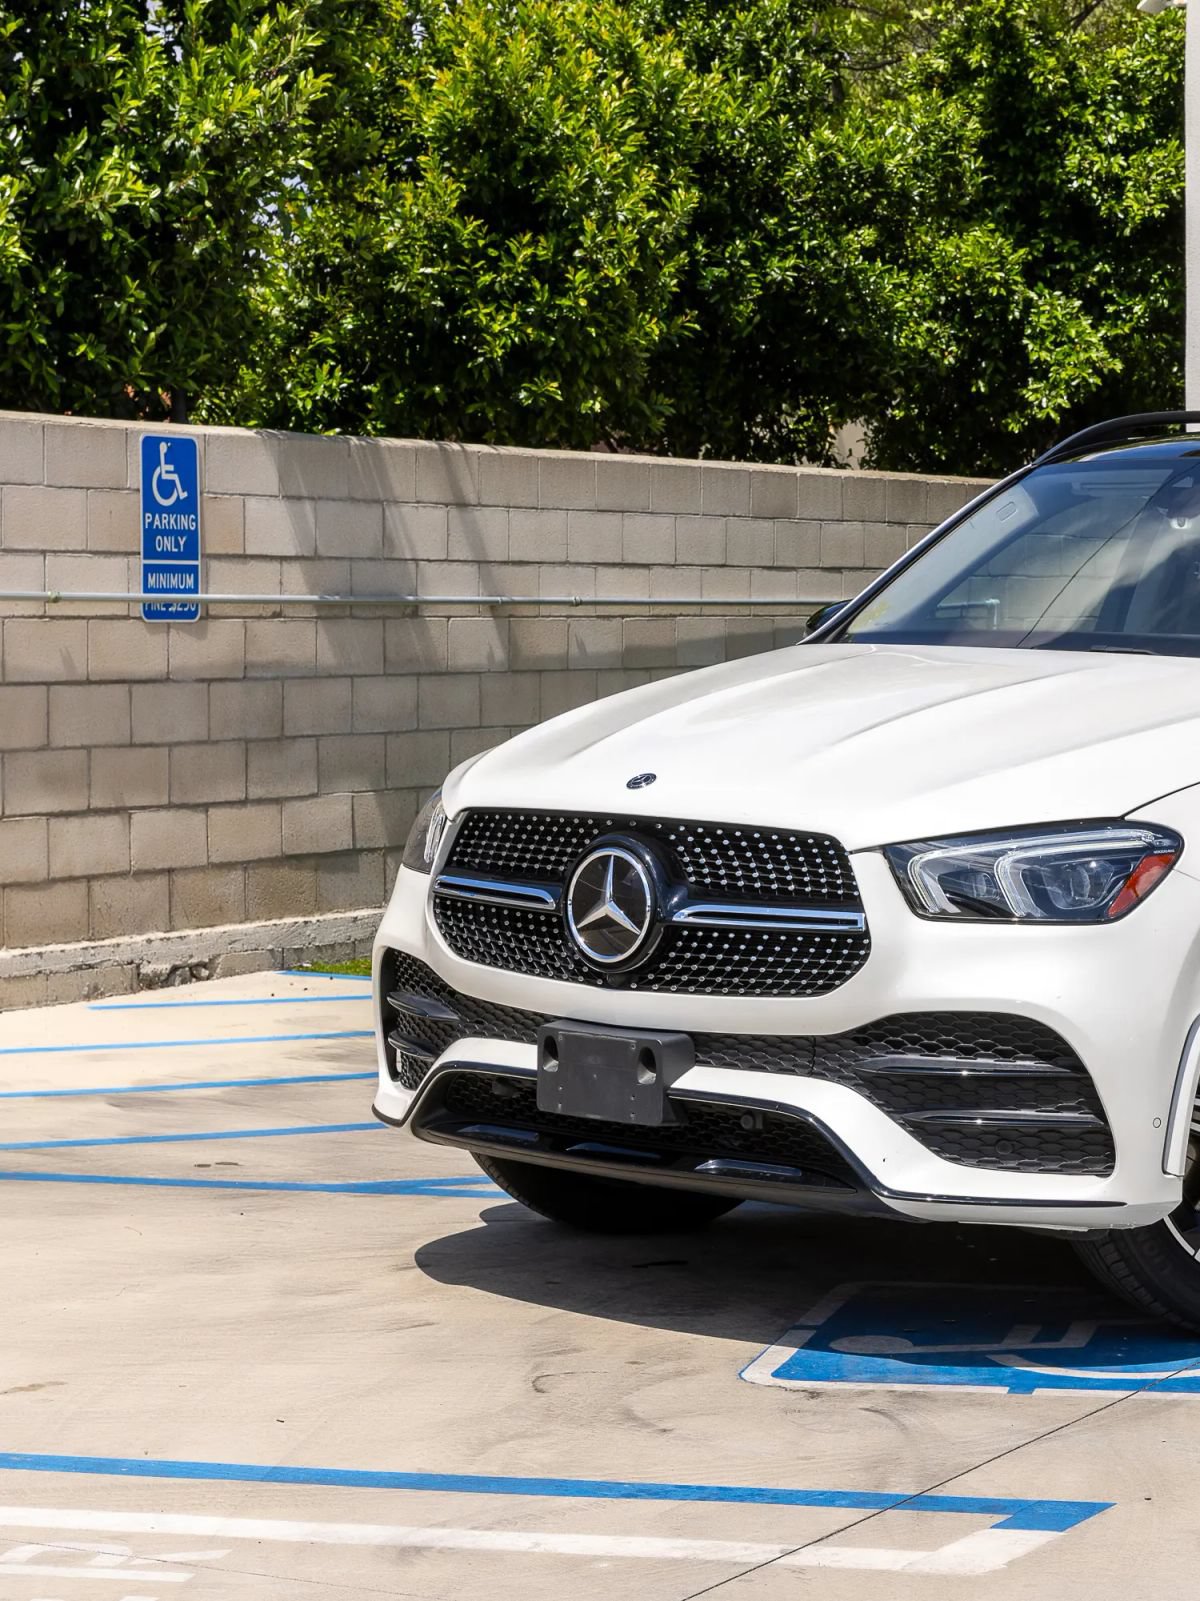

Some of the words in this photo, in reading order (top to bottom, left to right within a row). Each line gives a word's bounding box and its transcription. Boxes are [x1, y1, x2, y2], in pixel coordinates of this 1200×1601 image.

[145, 512, 197, 530] PARKING
[155, 535, 187, 552] ONLY
[147, 572, 195, 589] MINIMUM
